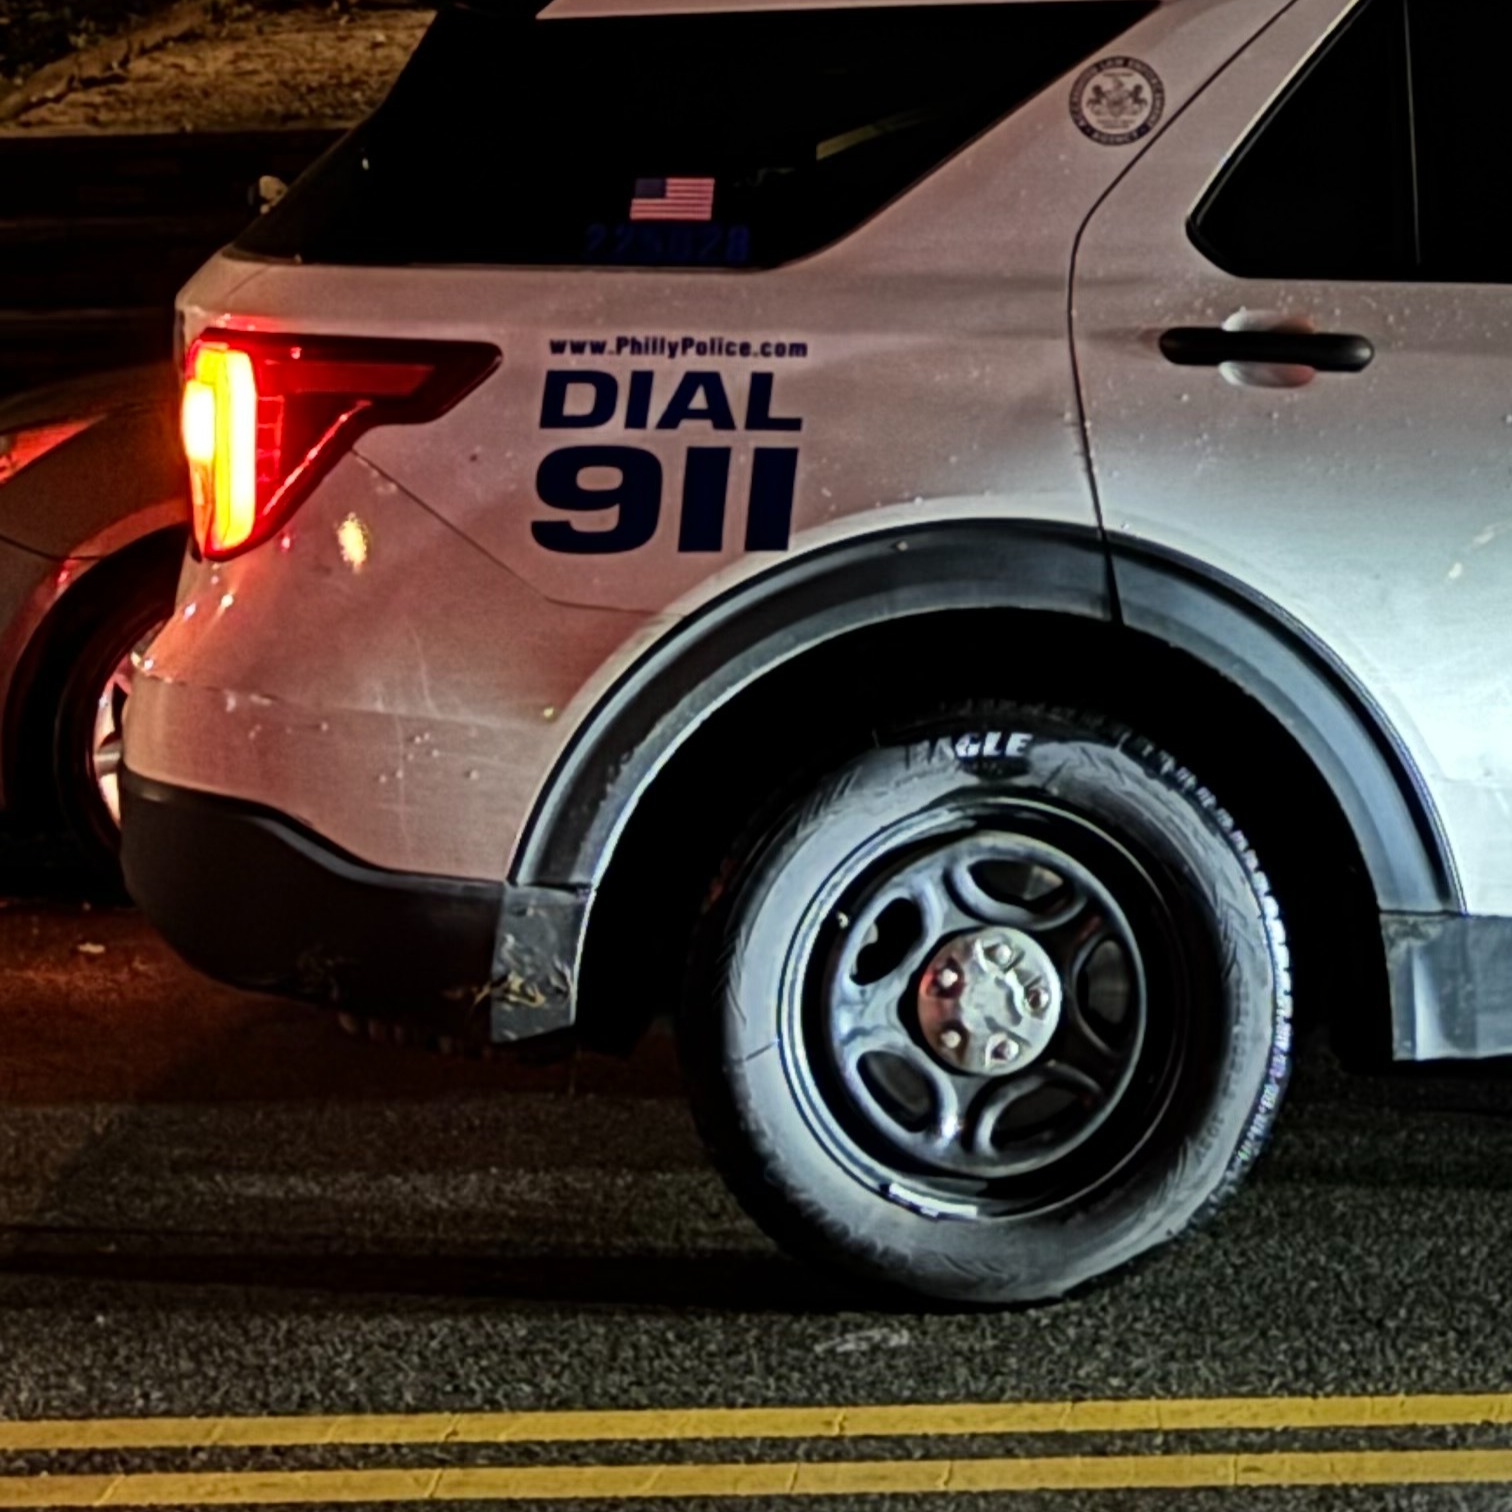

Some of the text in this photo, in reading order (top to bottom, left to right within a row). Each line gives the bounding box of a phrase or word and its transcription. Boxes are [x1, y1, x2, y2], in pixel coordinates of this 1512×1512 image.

[549, 336, 809, 360] www.PhillyPolice.com
[539, 369, 804, 432] DIAL
[531, 444, 799, 555] 911
